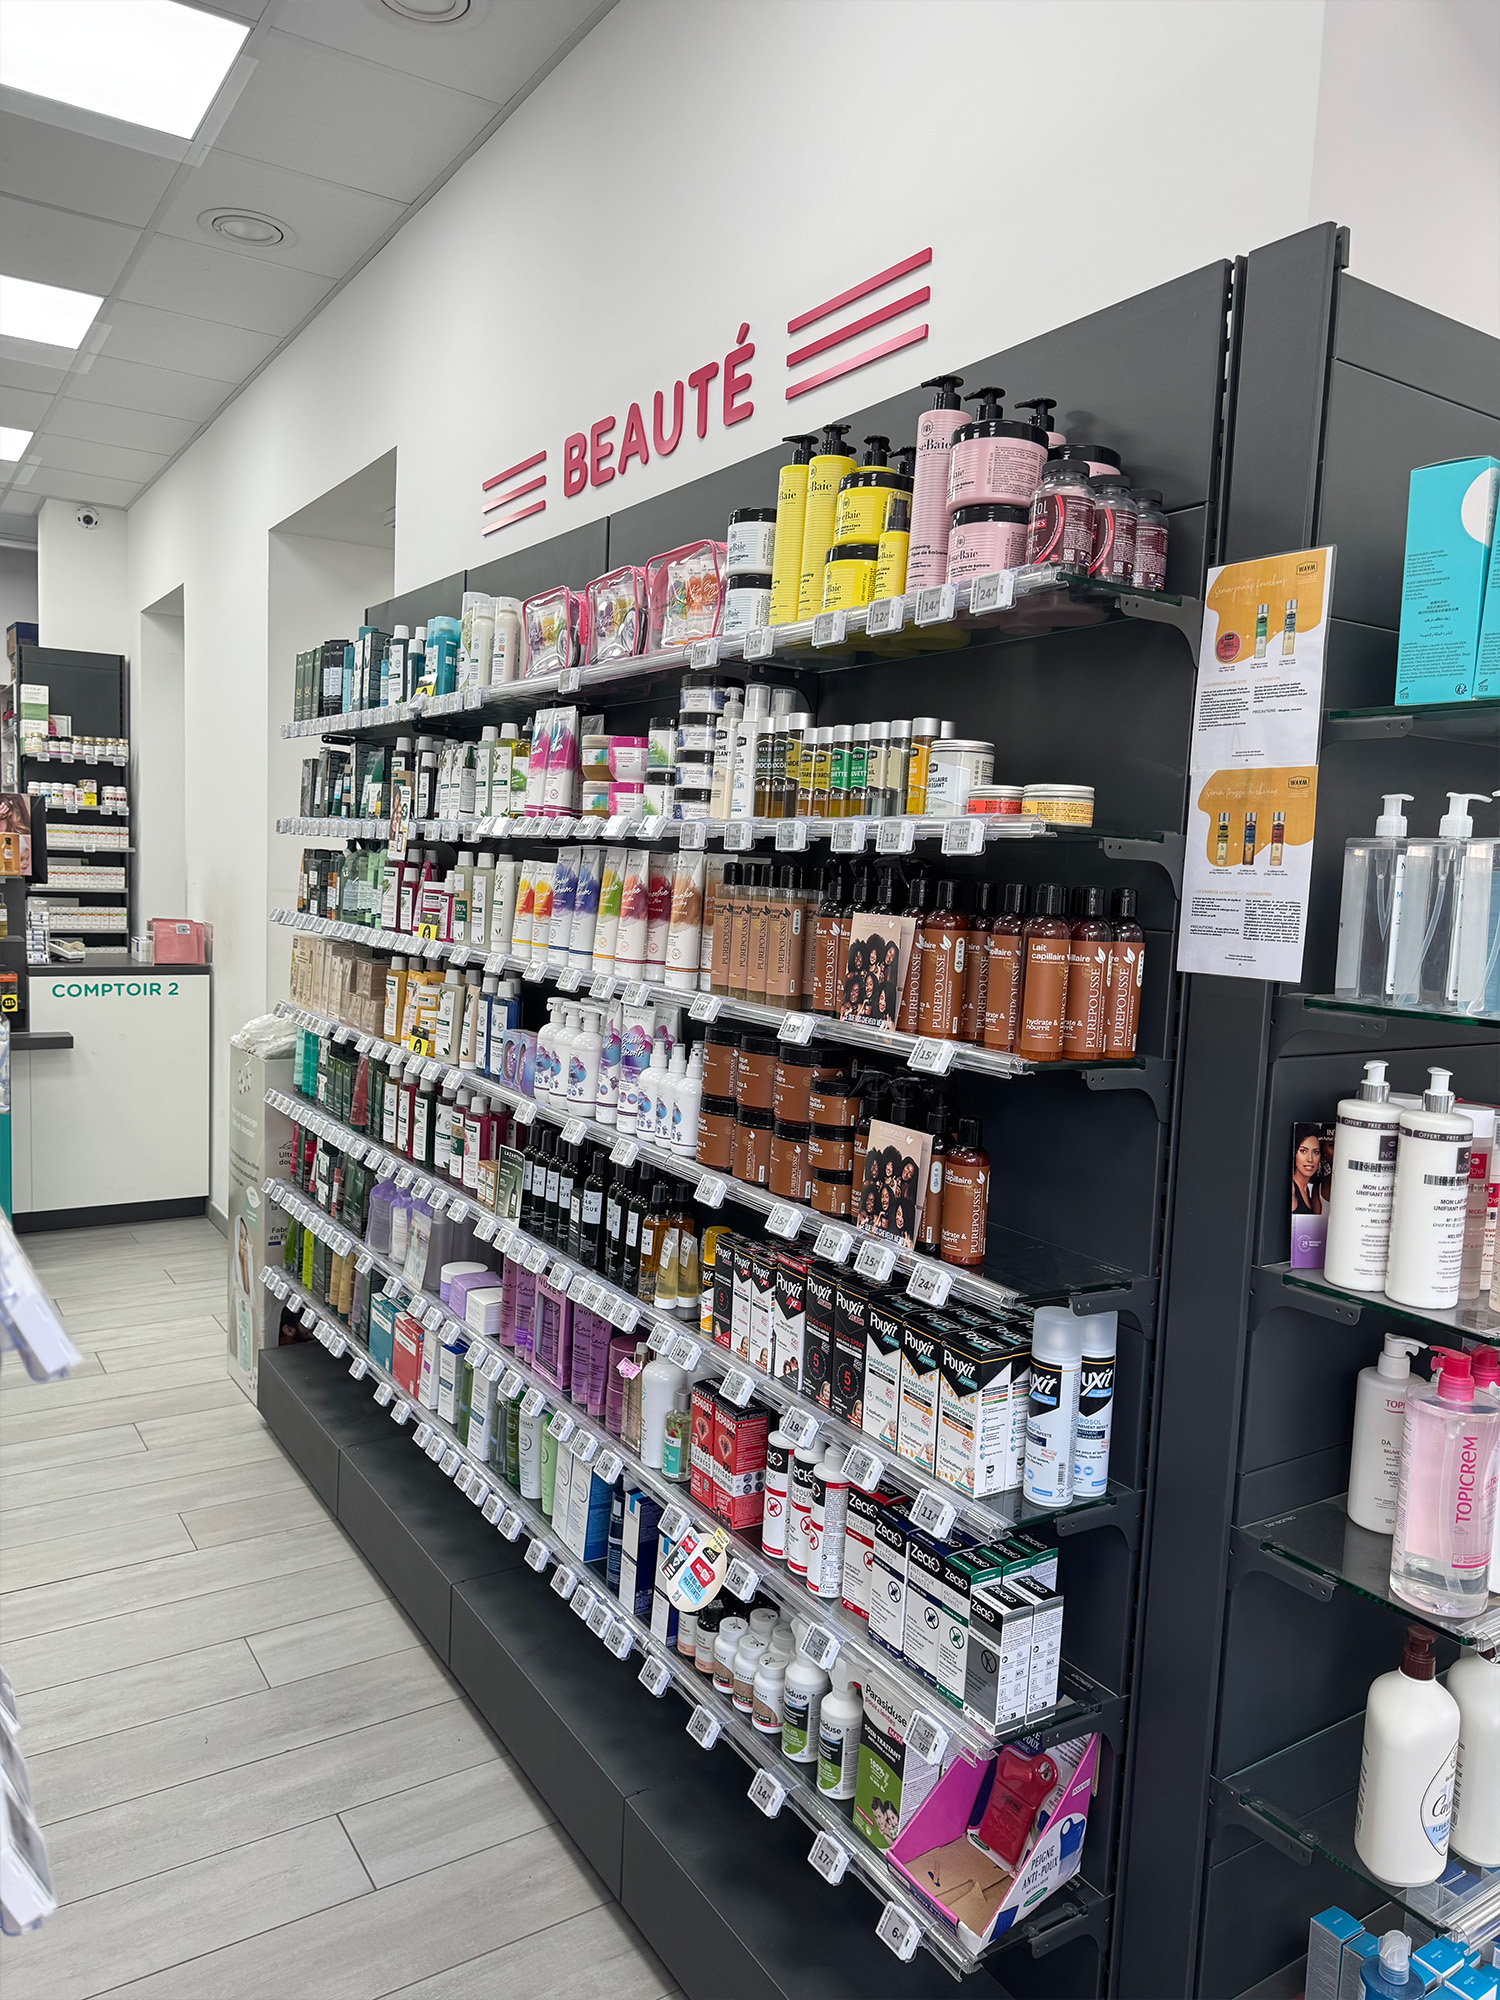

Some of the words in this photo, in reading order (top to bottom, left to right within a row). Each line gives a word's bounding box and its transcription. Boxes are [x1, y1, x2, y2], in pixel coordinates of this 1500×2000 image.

[563, 322, 756, 498] BEAUTÉ
[918, 437, 952, 452] seBaie
[777, 920, 788, 974] PUREPOUSSE
[1031, 952, 1066, 963] capillaire
[1032, 943, 1047, 952] Lait
[1069, 954, 1091, 963] illaire
[824, 939, 836, 1007] PUREPOUSSE
[52, 982, 162, 998] COMPTOIR
[168, 982, 180, 997] 2
[908, 952, 922, 1026] PUREPOUSSE
[932, 954, 946, 1029] PUREPOUSSE
[1085, 967, 1101, 1048] PUREPOUSSE
[1113, 967, 1130, 1047] PUREPOUSSE
[1027, 1018, 1052, 1027] hydrate
[1344, 1117, 1363, 1128] OFFERT
[1367, 1122, 1382, 1130] FREE
[1418, 1131, 1439, 1141] OFFERT
[271, 1226, 288, 1234] Fabr
[970, 1187, 982, 1254] PUREPOUSSE
[777, 1271, 803, 1301] Pouxit
[807, 1275, 832, 1303] Pouxit
[836, 1290, 865, 1319] Pouxit
[869, 1311, 898, 1339] Pouxit
[905, 1329, 935, 1358] Pouxit
[813, 1355, 820, 1368] 5
[943, 1349, 976, 1380] Pouxit
[844, 1374, 851, 1386] 5
[1030, 1372, 1058, 1398] uxit
[1082, 1368, 1114, 1397] uxit
[941, 1396, 976, 1421] SHAMPOOING
[866, 1684, 908, 1728] Parasidose
[1031, 1845, 1056, 1871] PEIGNE
[1022, 1856, 1059, 1891] ANTI-POUX
